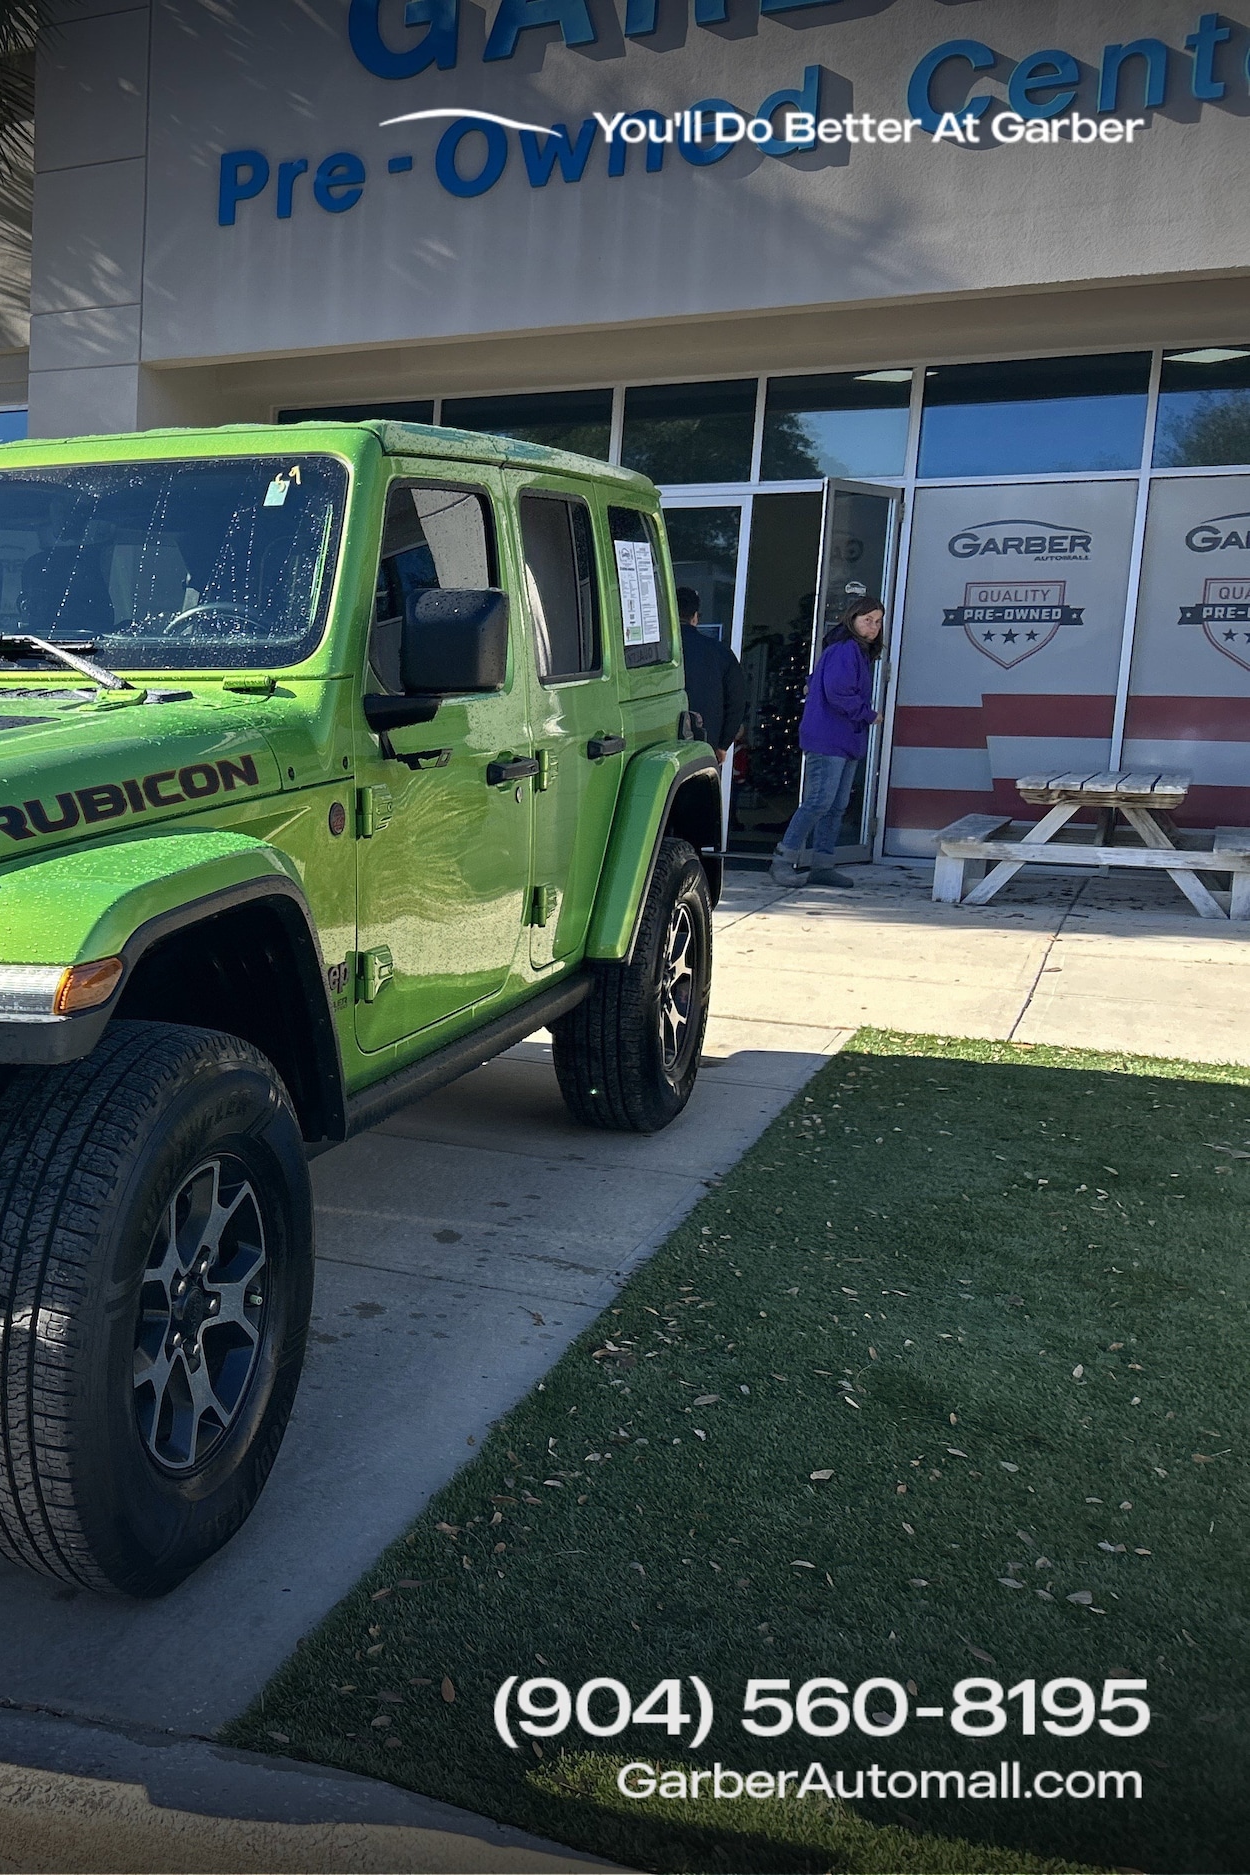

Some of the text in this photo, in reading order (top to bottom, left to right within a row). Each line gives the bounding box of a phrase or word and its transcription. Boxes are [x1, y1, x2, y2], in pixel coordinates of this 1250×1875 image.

[907, 13, 1250, 138] Cent
[948, 532, 1092, 559] GARBER
[978, 589, 1051, 603] QUALITY
[963, 608, 1062, 621] PRE-OWNED
